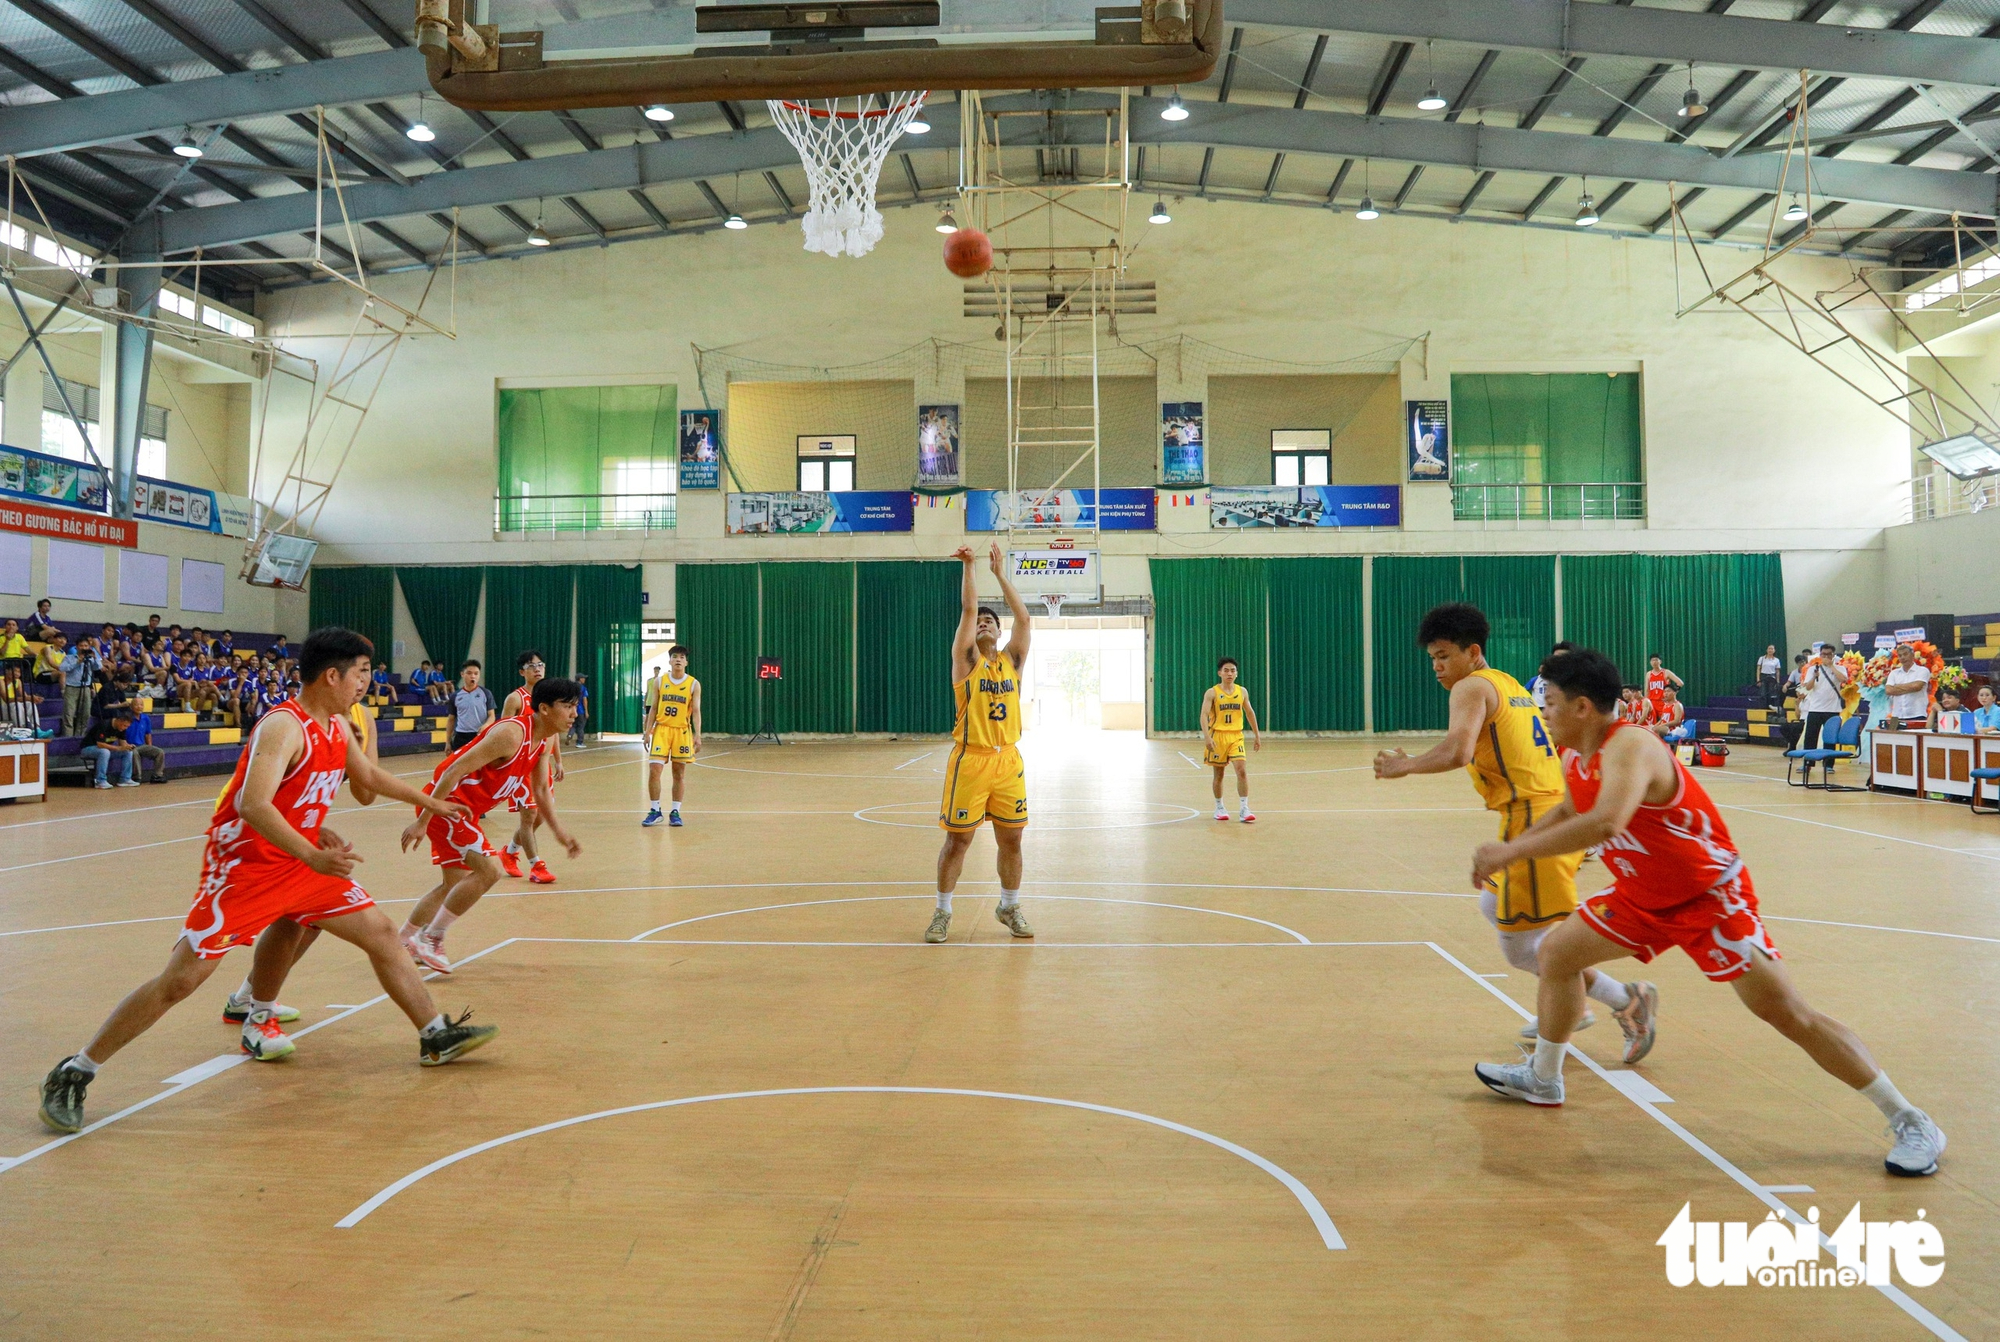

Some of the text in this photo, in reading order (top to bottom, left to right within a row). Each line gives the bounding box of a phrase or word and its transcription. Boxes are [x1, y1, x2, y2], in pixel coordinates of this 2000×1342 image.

[63, 516, 82, 535] BÁC
[110, 526, 125, 543] ĐẠI
[760, 665, 778, 678] 24
[664, 706, 678, 717] 98
[989, 703, 1006, 721] 23
[1225, 714, 1232, 723] 11
[1532, 716, 1553, 757] 4
[342, 886, 367, 904] 30
